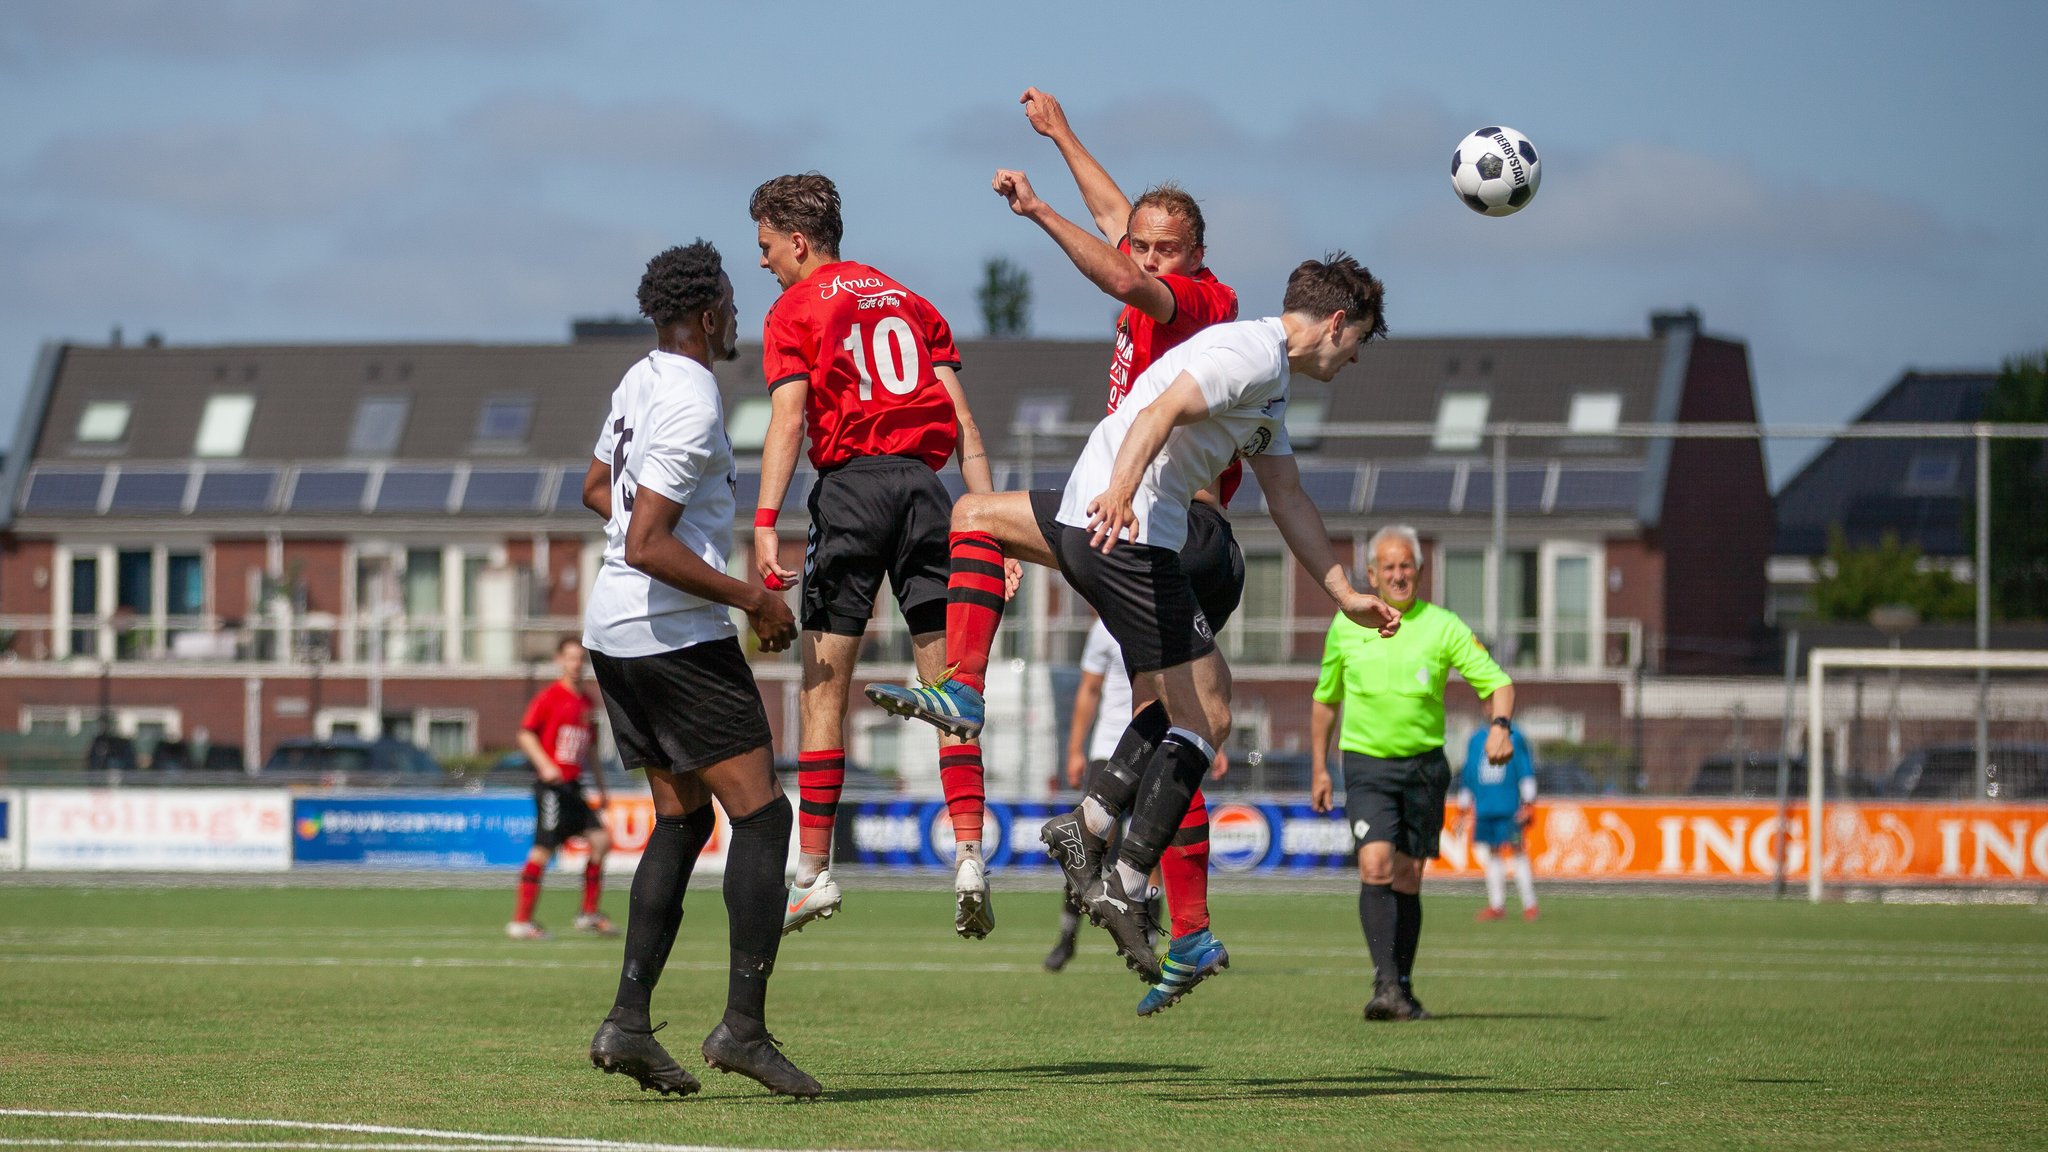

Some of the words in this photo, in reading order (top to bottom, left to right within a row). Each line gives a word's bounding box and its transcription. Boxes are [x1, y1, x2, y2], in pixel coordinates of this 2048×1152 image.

[1493, 133, 1526, 186] DERBYSTAR
[819, 275, 885, 300] Amici
[857, 298, 878, 310] Taste
[843, 316, 919, 401] 10
[1657, 814, 1807, 876] ING
